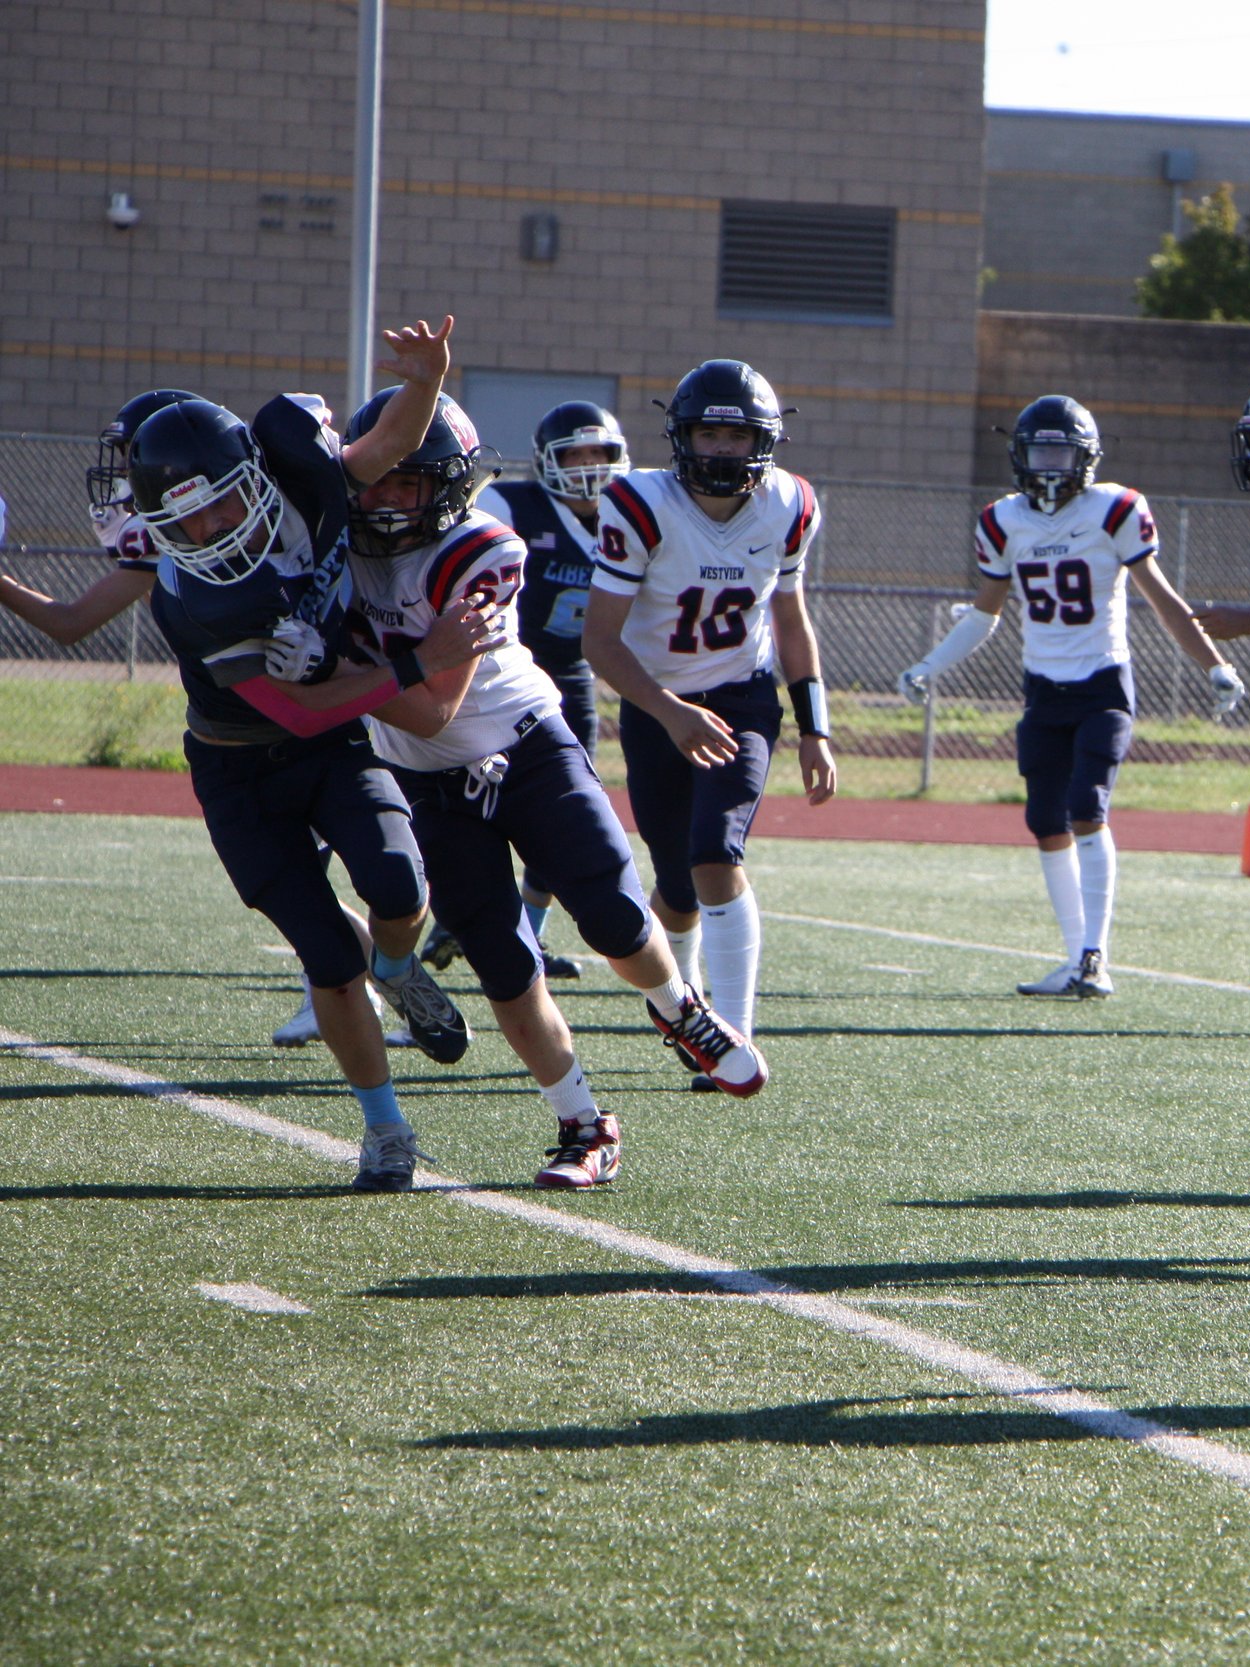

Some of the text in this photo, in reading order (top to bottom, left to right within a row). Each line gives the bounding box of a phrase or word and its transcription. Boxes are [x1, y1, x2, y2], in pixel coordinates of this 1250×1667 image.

[708, 406, 739, 416] Riddell
[169, 479, 198, 500] Riddell
[543, 560, 594, 586] LIBE
[699, 565, 745, 580] WESTVIEW
[1016, 558, 1096, 626] 59
[520, 720, 532, 731] XL
